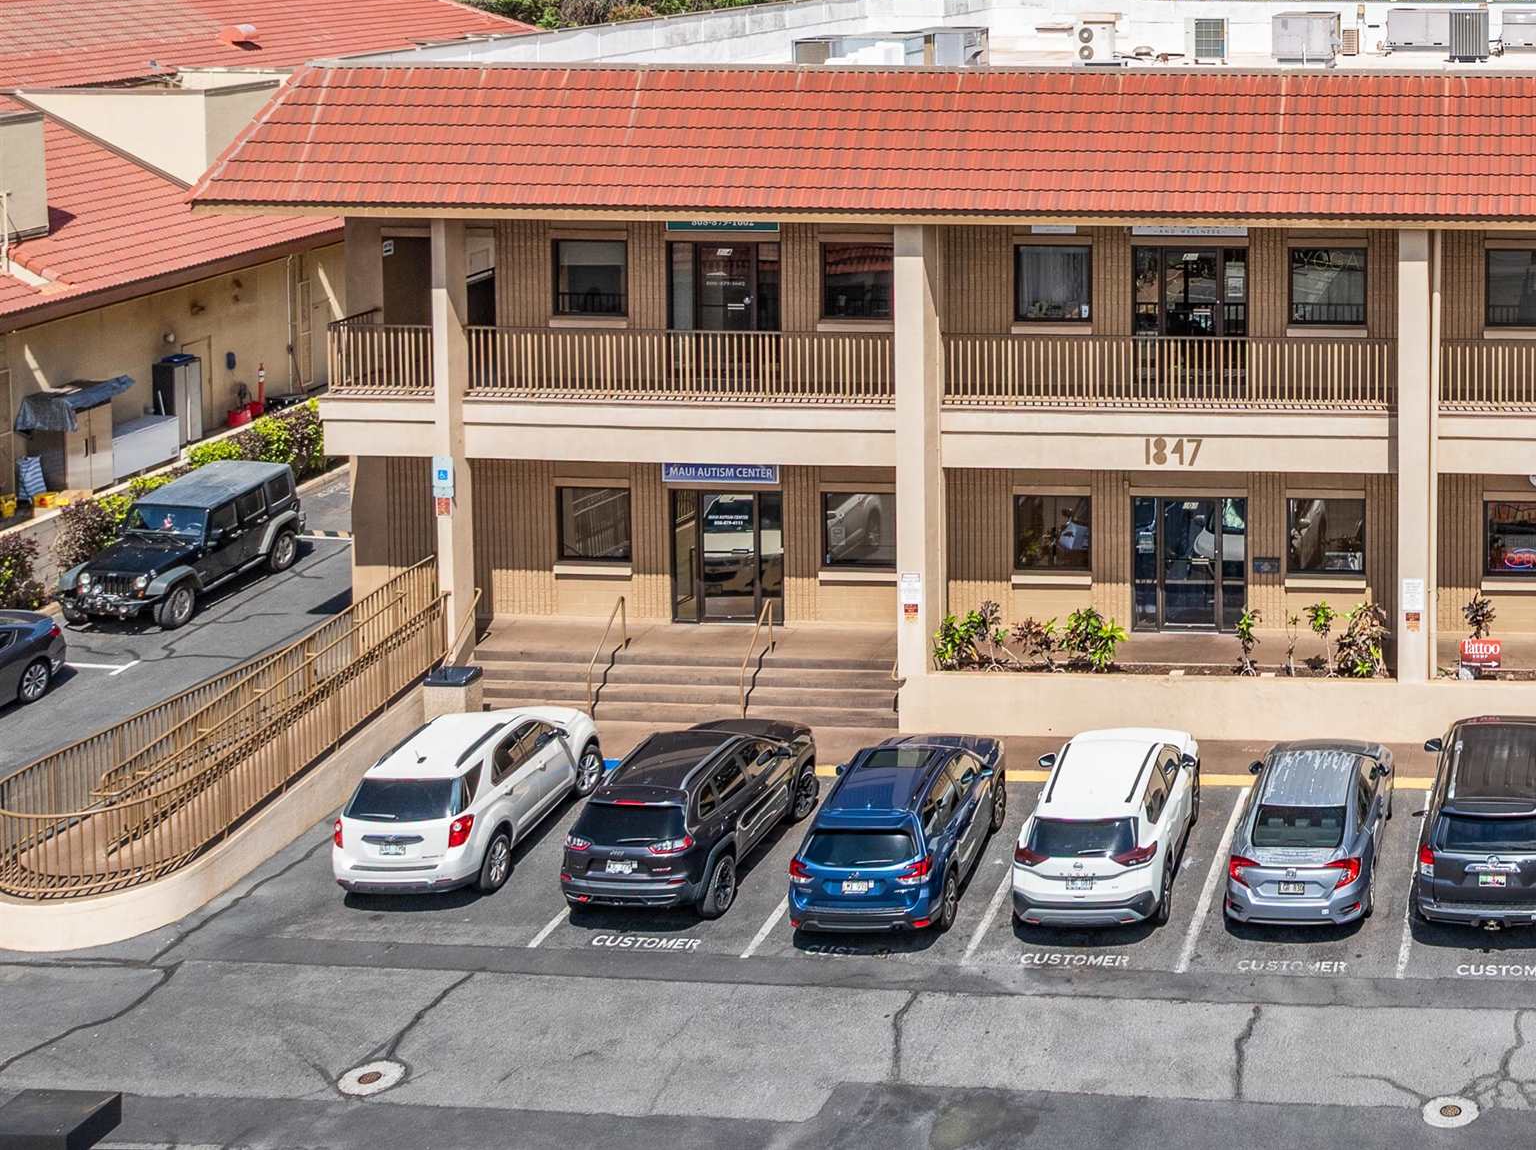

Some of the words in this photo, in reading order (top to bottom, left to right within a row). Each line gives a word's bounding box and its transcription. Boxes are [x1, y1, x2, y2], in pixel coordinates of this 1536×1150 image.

[1145, 438, 1203, 466] 1847
[669, 467, 695, 476] MAUI
[697, 468, 734, 477] AUTISM
[736, 468, 773, 479] CENTER
[1462, 640, 1501, 655] Tattoo
[592, 935, 701, 950] CUSTOMER
[1020, 953, 1130, 967] CUSTOMER
[1238, 960, 1348, 972] CUSTOMER
